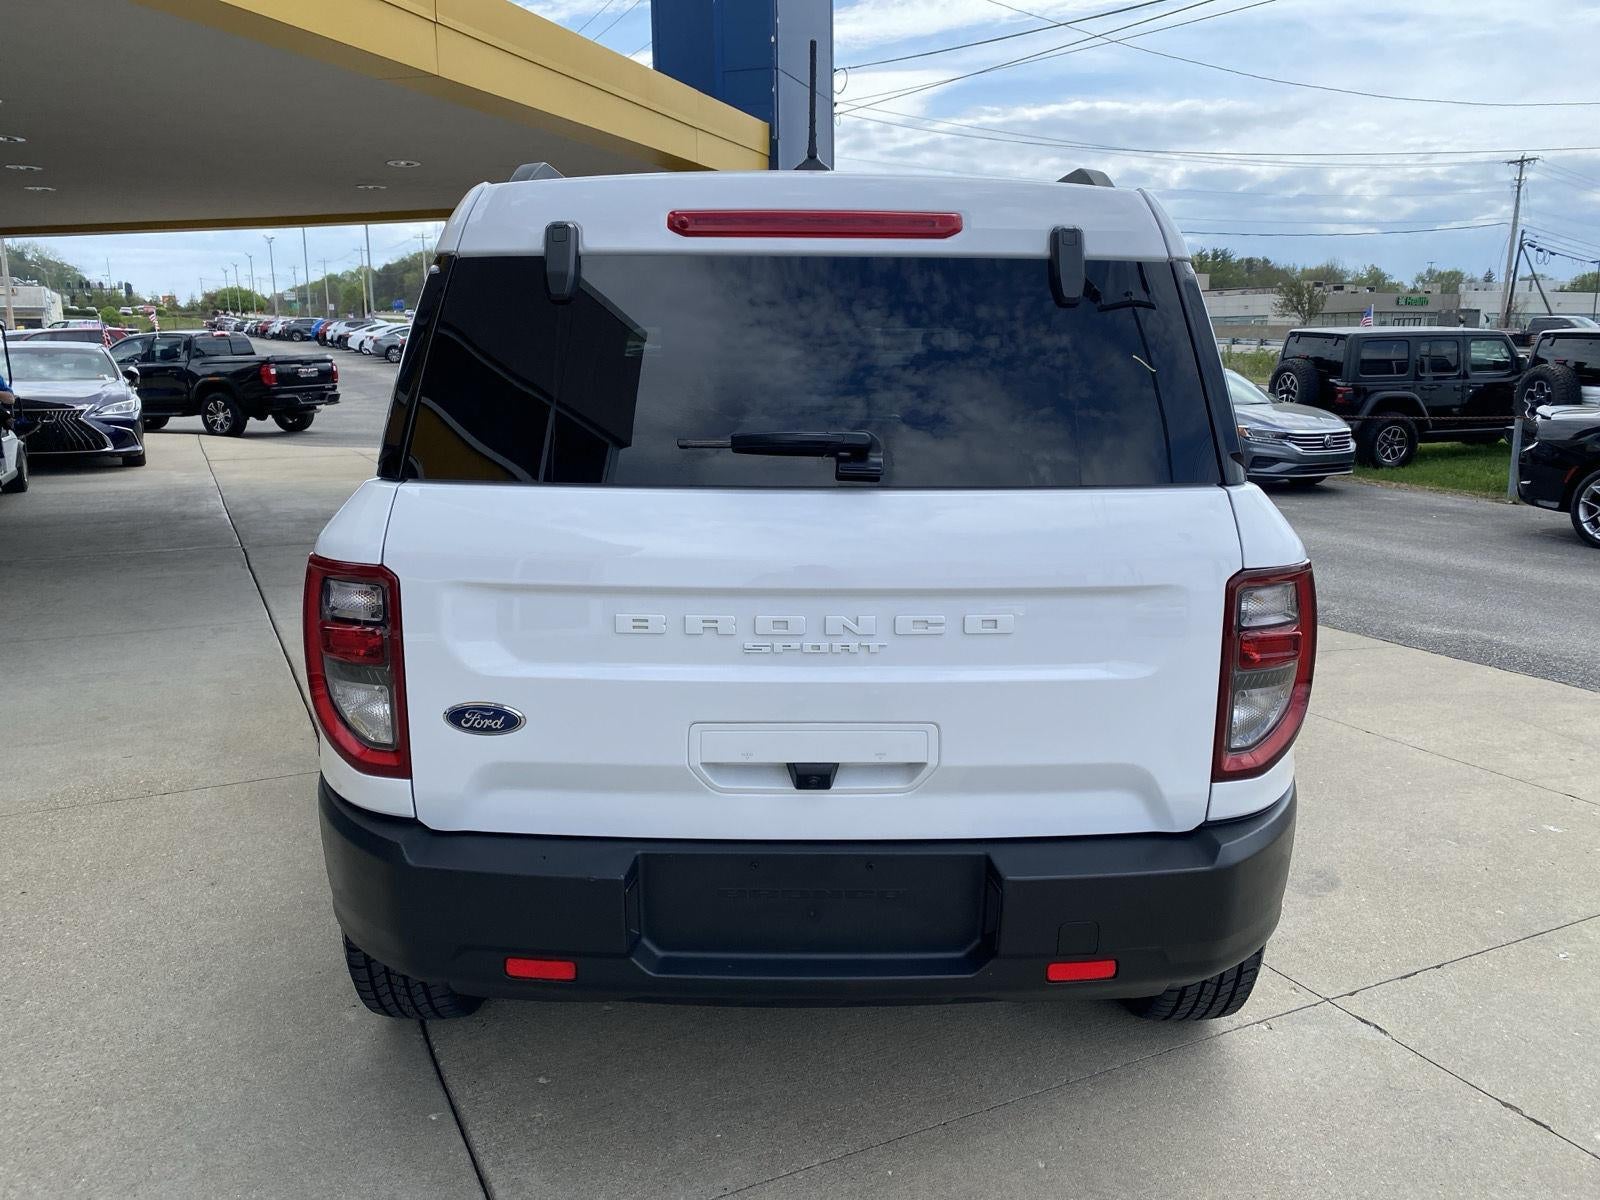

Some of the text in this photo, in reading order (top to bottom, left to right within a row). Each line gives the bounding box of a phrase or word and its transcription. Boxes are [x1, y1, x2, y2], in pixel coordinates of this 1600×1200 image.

[615, 613, 1014, 635] BRONCO
[743, 642, 888, 654] SPORT
[461, 709, 504, 729] Ford
